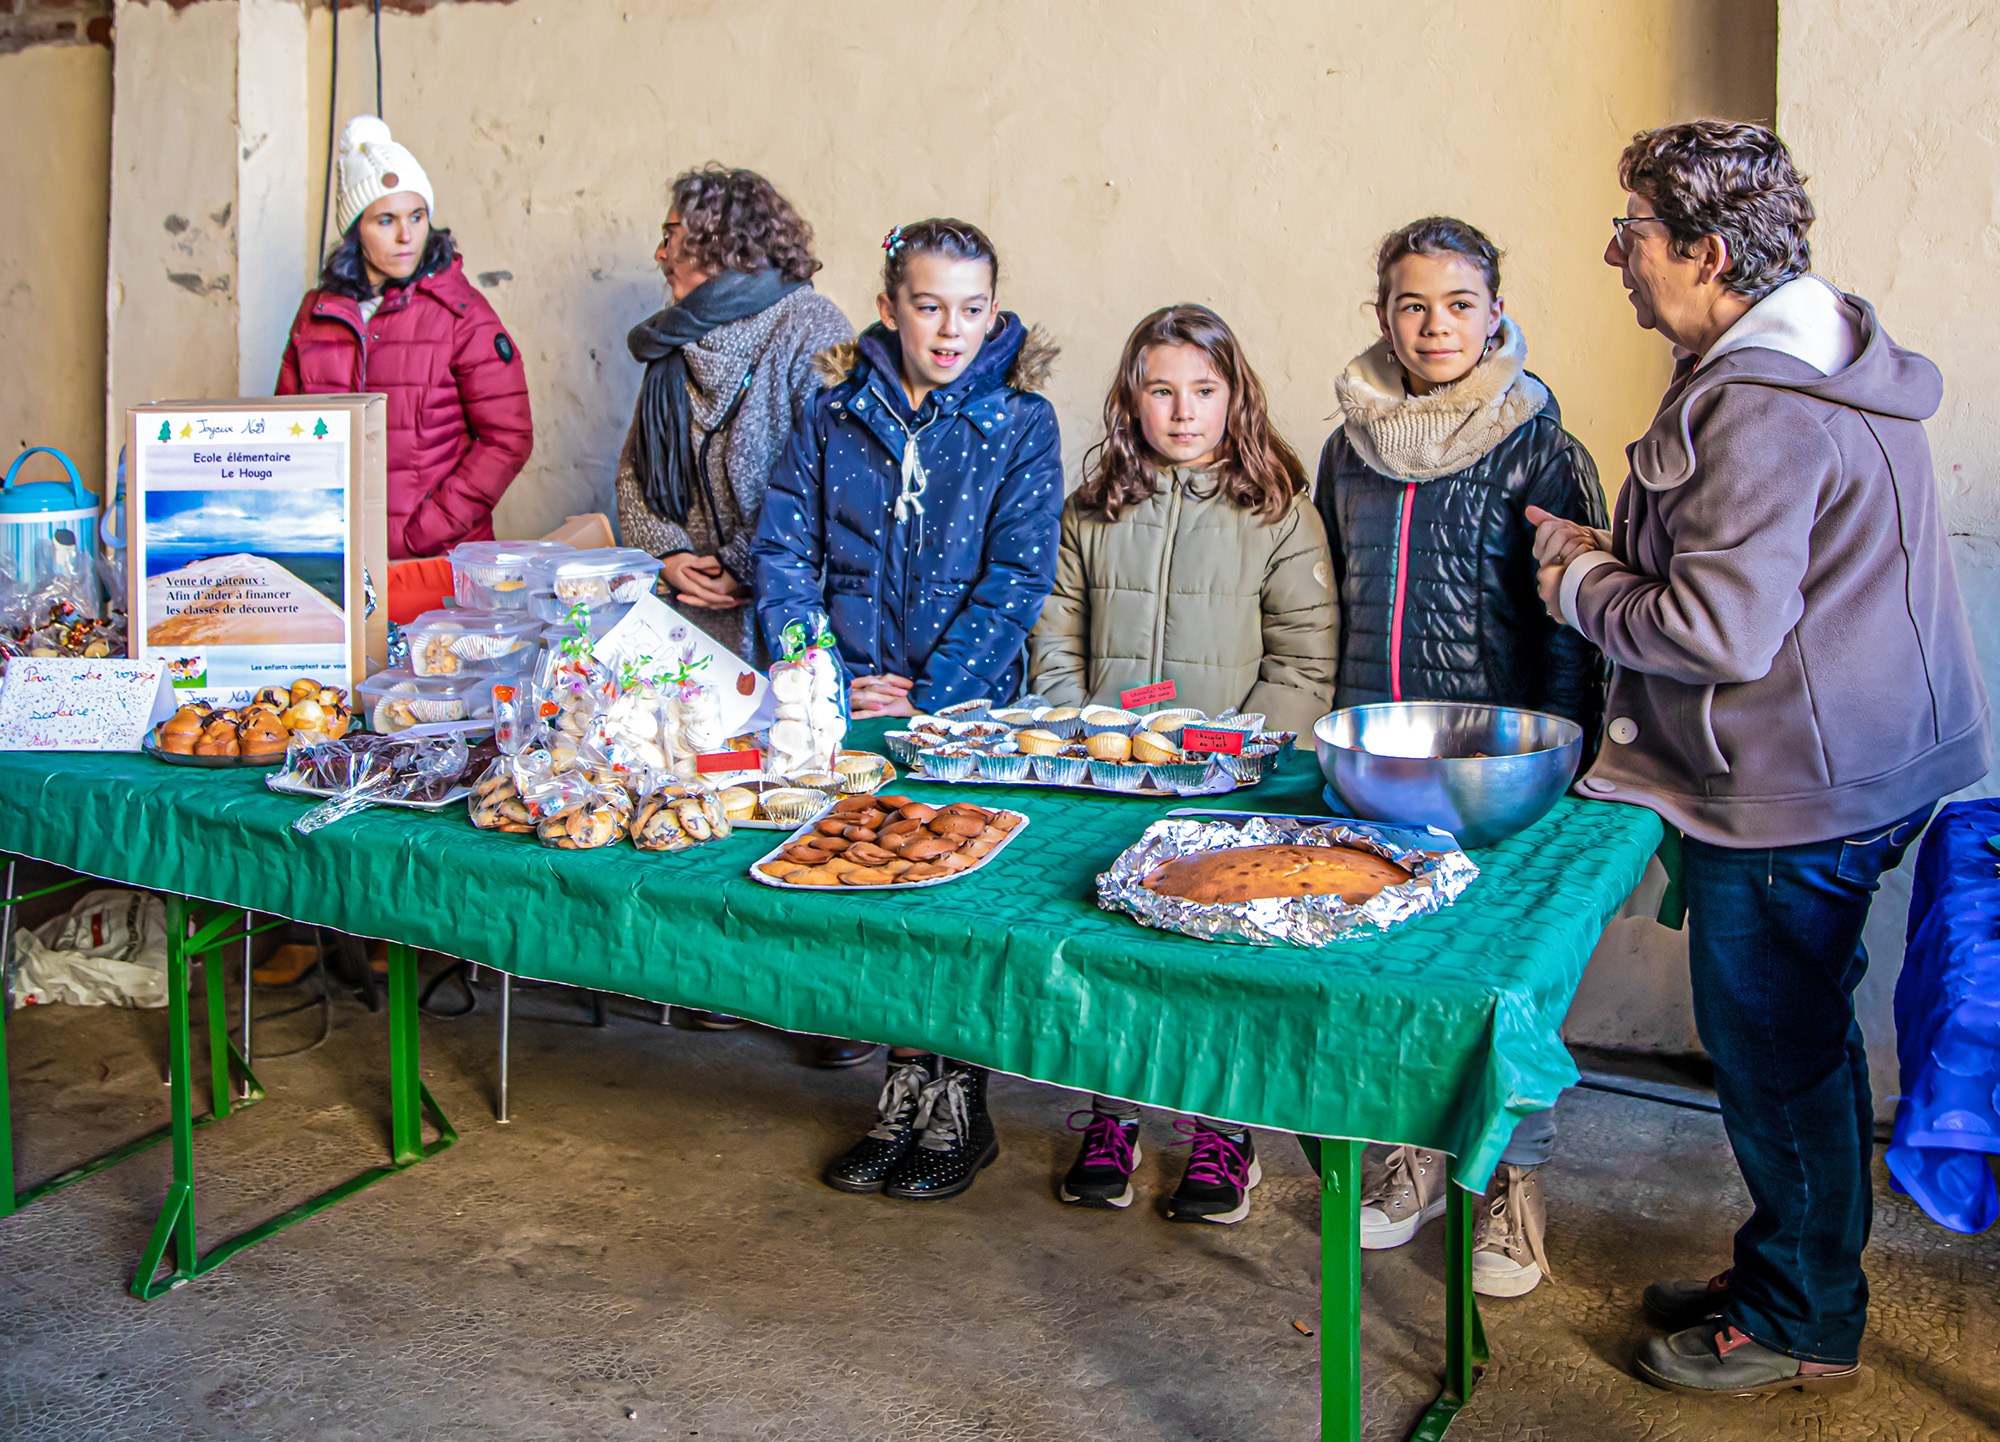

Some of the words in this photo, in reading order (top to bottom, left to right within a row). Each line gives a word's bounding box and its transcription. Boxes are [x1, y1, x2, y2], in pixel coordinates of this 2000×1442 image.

[196, 418, 234, 440] Joyeux
[193, 452, 222, 463] Ecole
[226, 451, 291, 463] élémentaire
[221, 468, 235, 479] Le
[239, 468, 273, 481] Houga
[166, 576, 197, 587] Vente
[200, 576, 213, 586] de
[215, 575, 259, 588] gâteaux
[166, 591, 190, 601] Afin
[193, 590, 233, 601] d'aider
[235, 589, 243, 600] à
[245, 589, 292, 600] financer
[166, 605, 181, 615] les
[183, 604, 220, 615] classes
[223, 604, 236, 614] de
[238, 603, 299, 614] découverte
[264, 663, 288, 671] enfants
[290, 663, 319, 671] comptent
[24, 666, 53, 683] Pour
[71, 664, 102, 682] notre
[114, 670, 156, 686] voyage
[1195, 732, 1226, 741] chocolat
